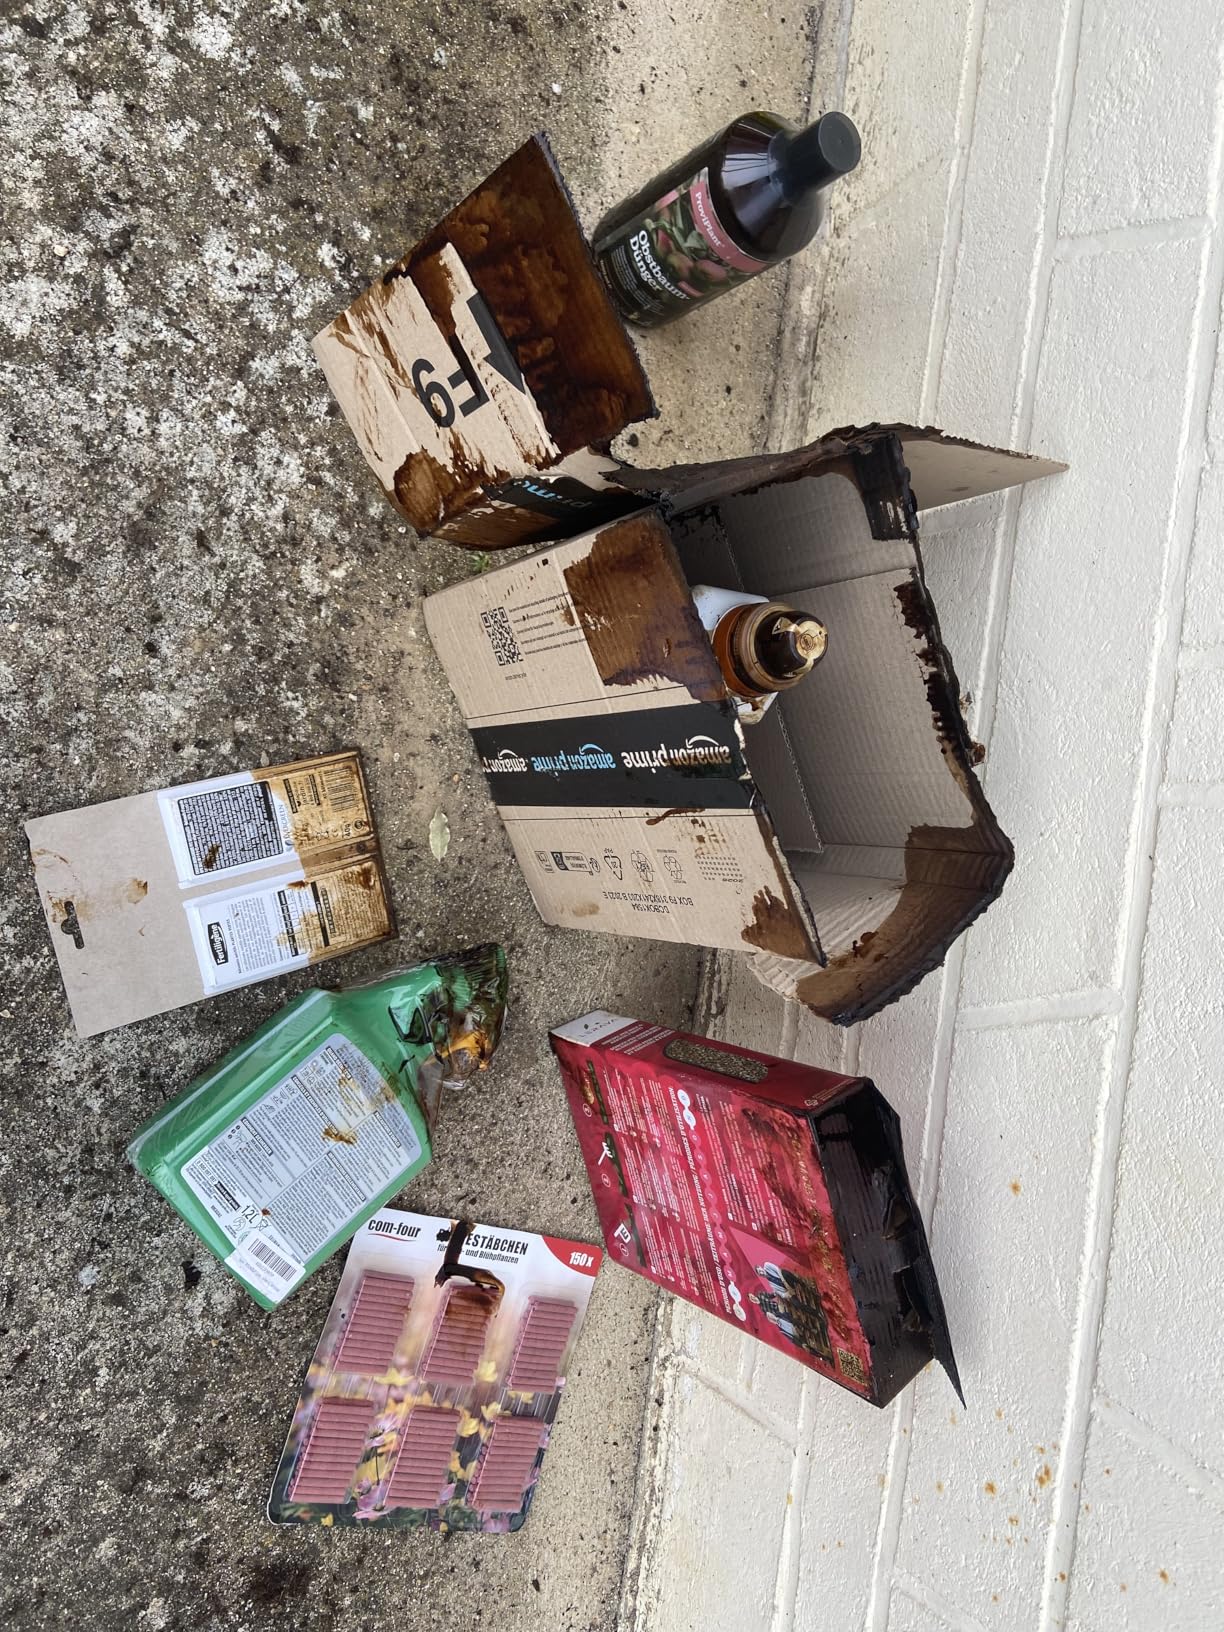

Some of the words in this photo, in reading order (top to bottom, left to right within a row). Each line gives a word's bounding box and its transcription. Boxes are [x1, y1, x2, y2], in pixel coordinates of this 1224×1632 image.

[695, 192, 721, 246] ProviPlant
[630, 235, 663, 291] Dünger
[411, 337, 490, 428] F9
[488, 757, 528, 773] amazon
[529, 750, 569, 776] prime
[567, 752, 616, 770] amazon
[619, 743, 670, 773] prime
[669, 745, 731, 766] amazon
[621, 892, 627, 900] B
[677, 896, 693, 905] BOX
[206, 923, 227, 964] Fertiligène
[368, 1219, 421, 1238] com-four
[465, 1248, 478, 1258] und
[478, 1250, 519, 1264] Blühpflanzen
